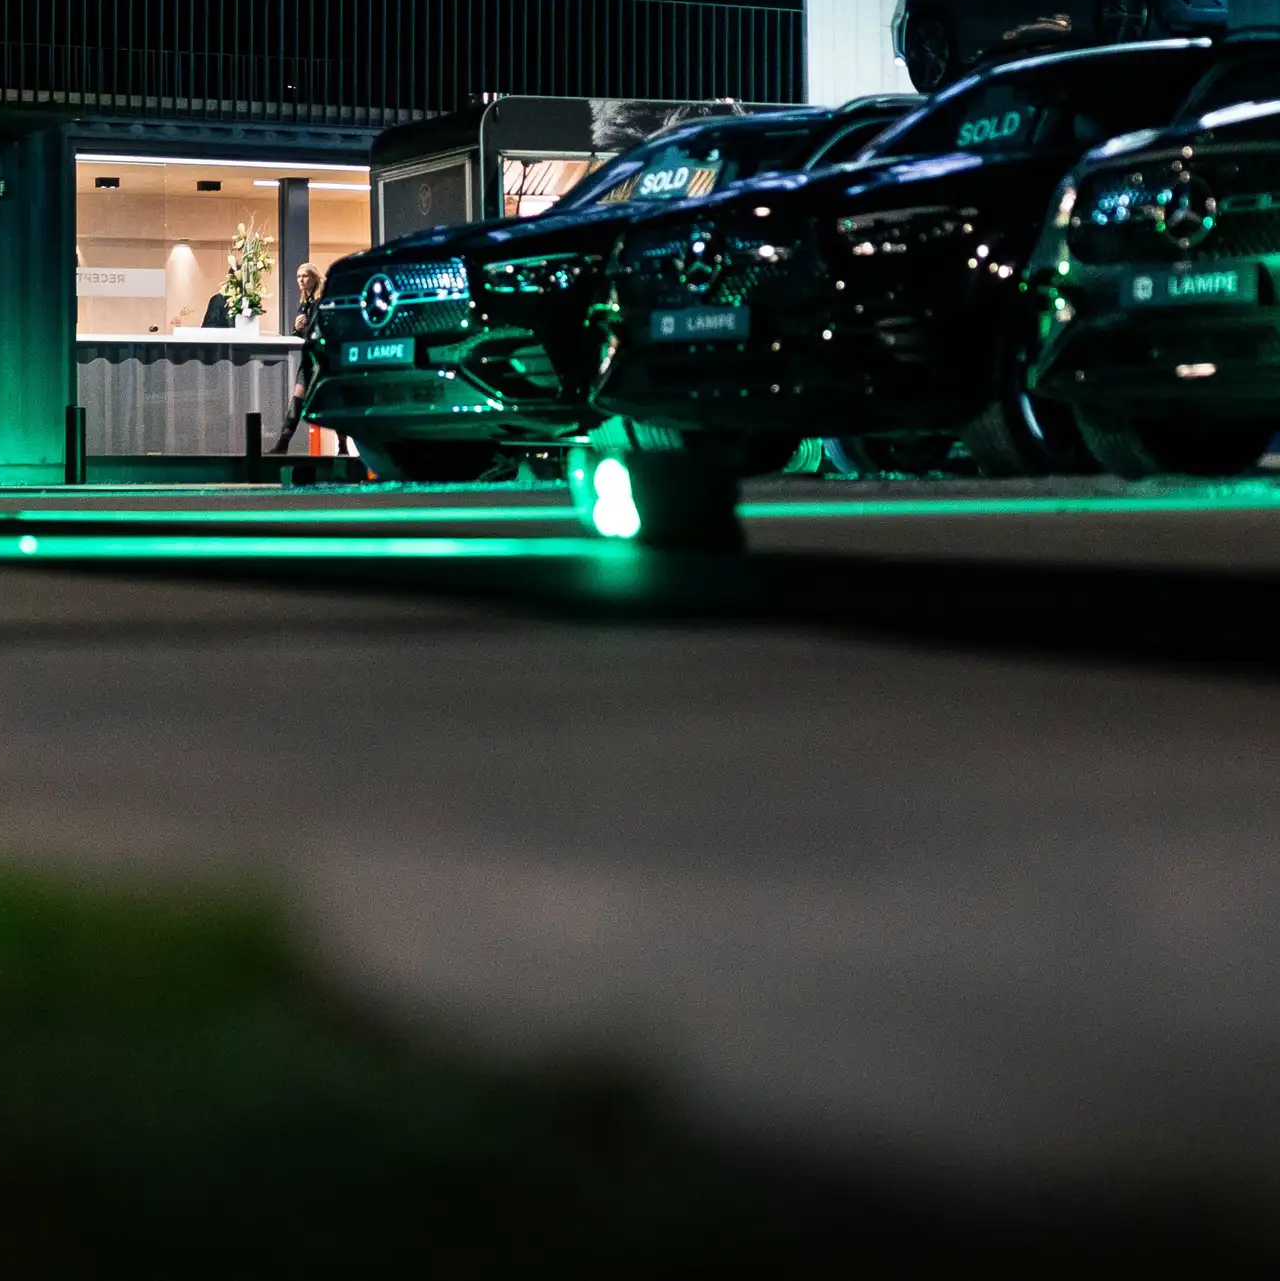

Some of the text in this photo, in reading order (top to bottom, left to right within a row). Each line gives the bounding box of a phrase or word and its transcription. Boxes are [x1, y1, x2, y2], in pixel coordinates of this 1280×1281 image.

[958, 111, 1021, 146] SOLD
[641, 167, 689, 195] SOLD
[1166, 271, 1238, 296] LAMPE
[685, 313, 737, 332] LAMPE
[367, 343, 405, 359] LAMPE
